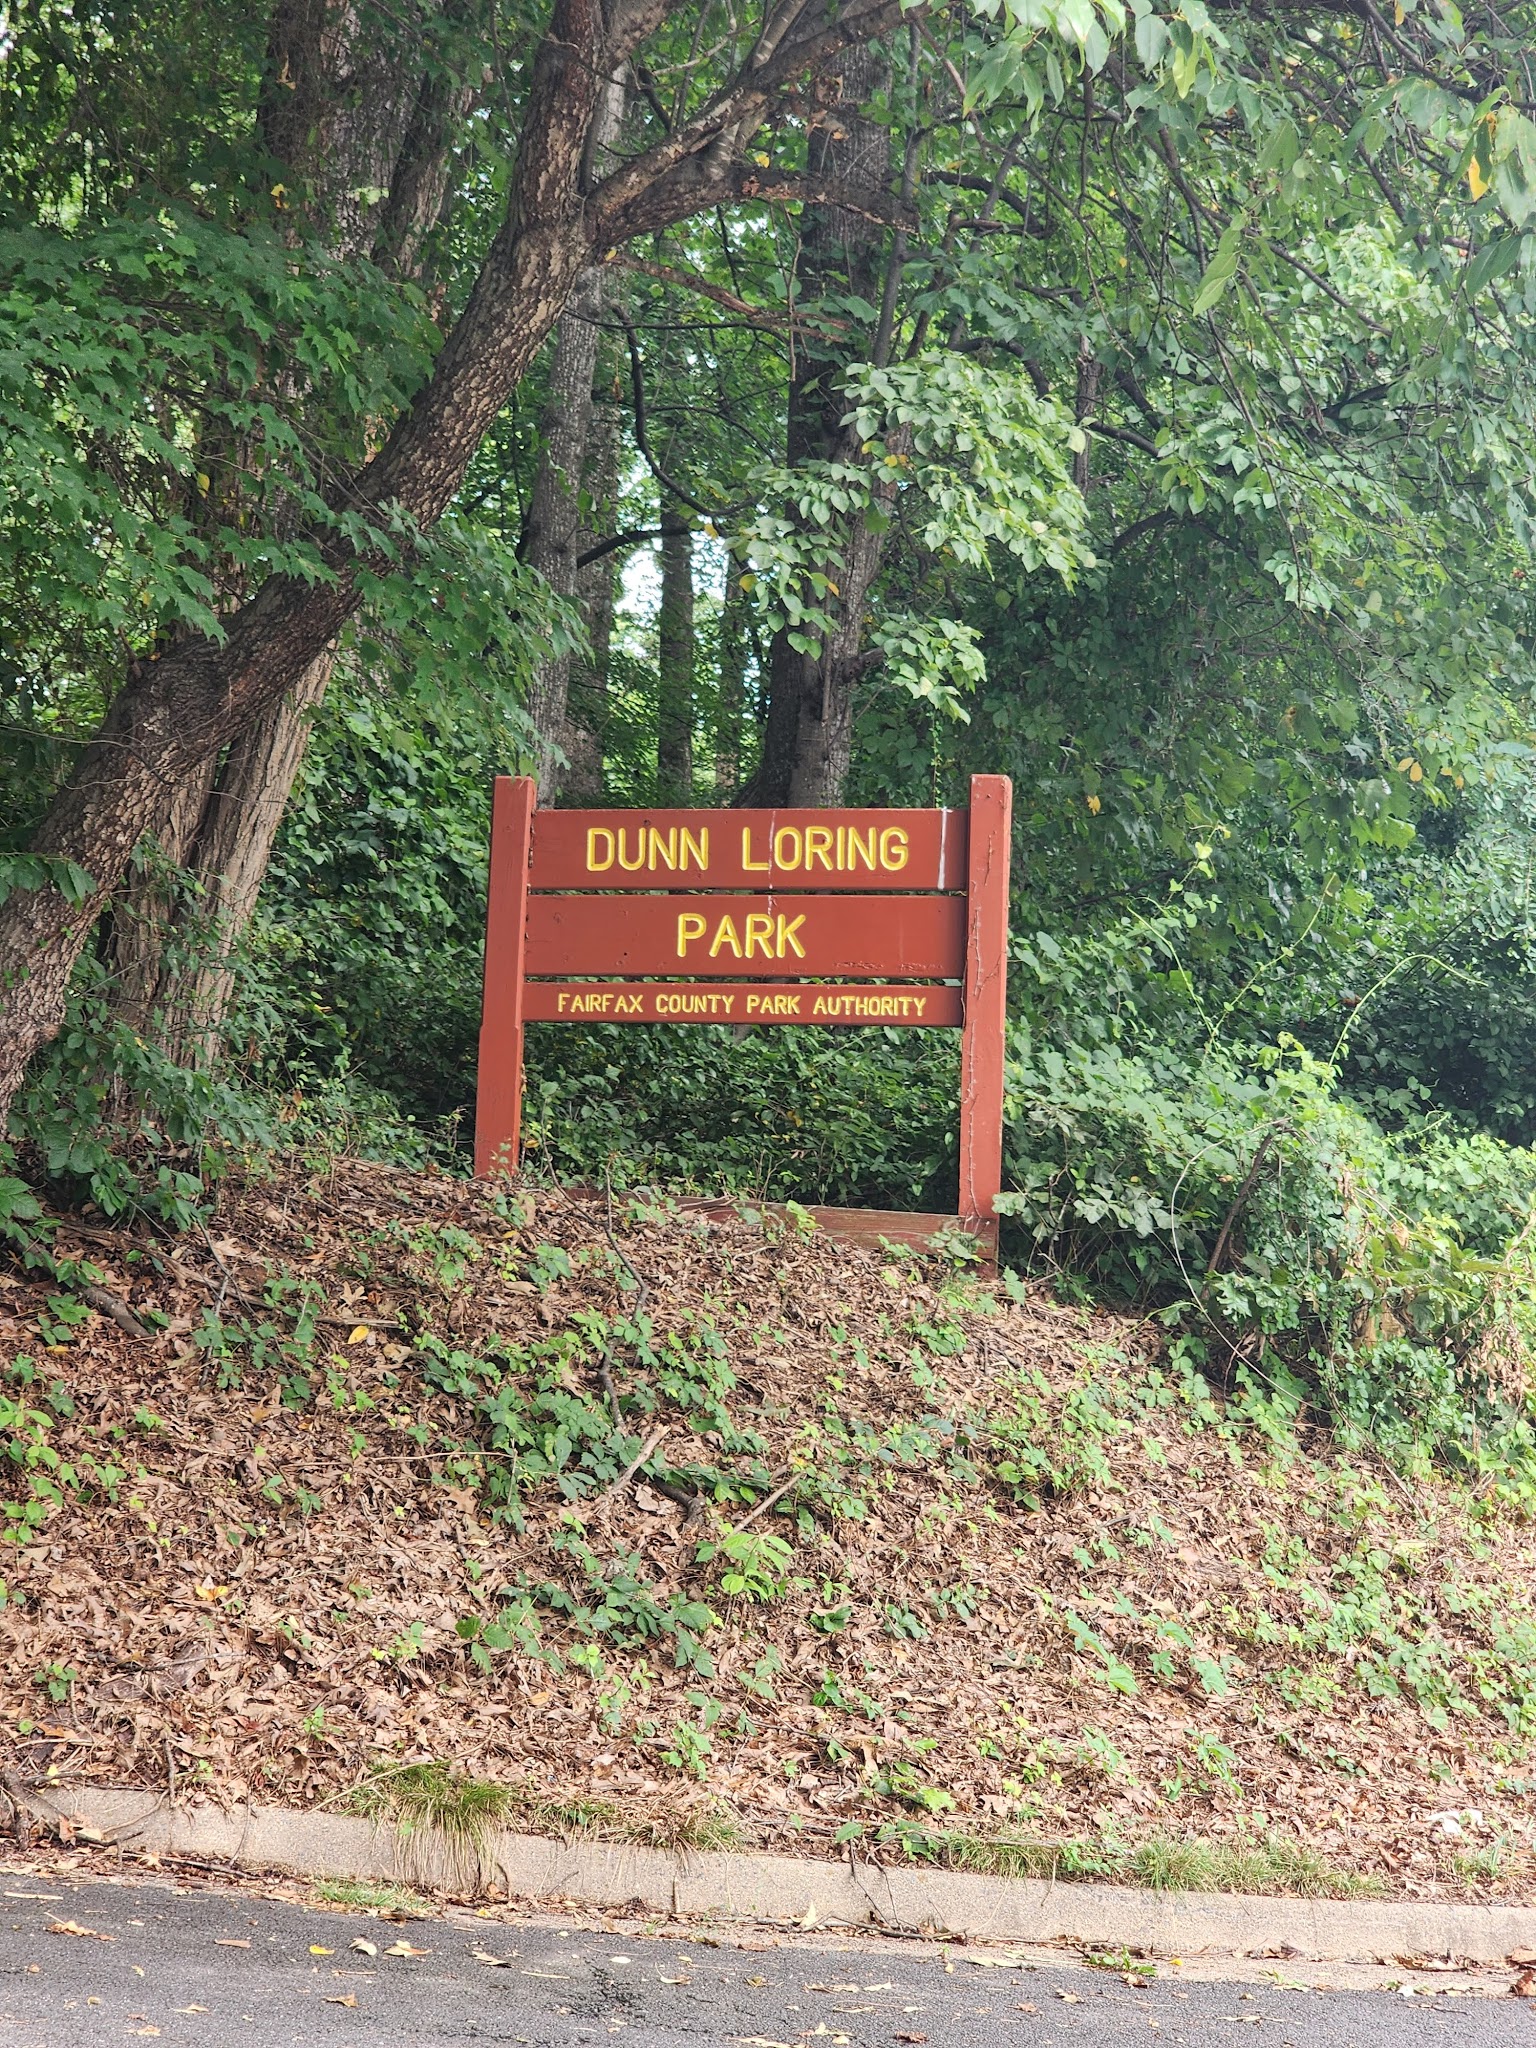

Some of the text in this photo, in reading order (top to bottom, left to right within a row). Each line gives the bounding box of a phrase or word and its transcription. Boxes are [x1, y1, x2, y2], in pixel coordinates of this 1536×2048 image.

[586, 826, 909, 871] DUNN LORING
[676, 913, 806, 959] PARK
[557, 993, 927, 1017] FAIRFAX COUNTY PARK AUTHORITY
